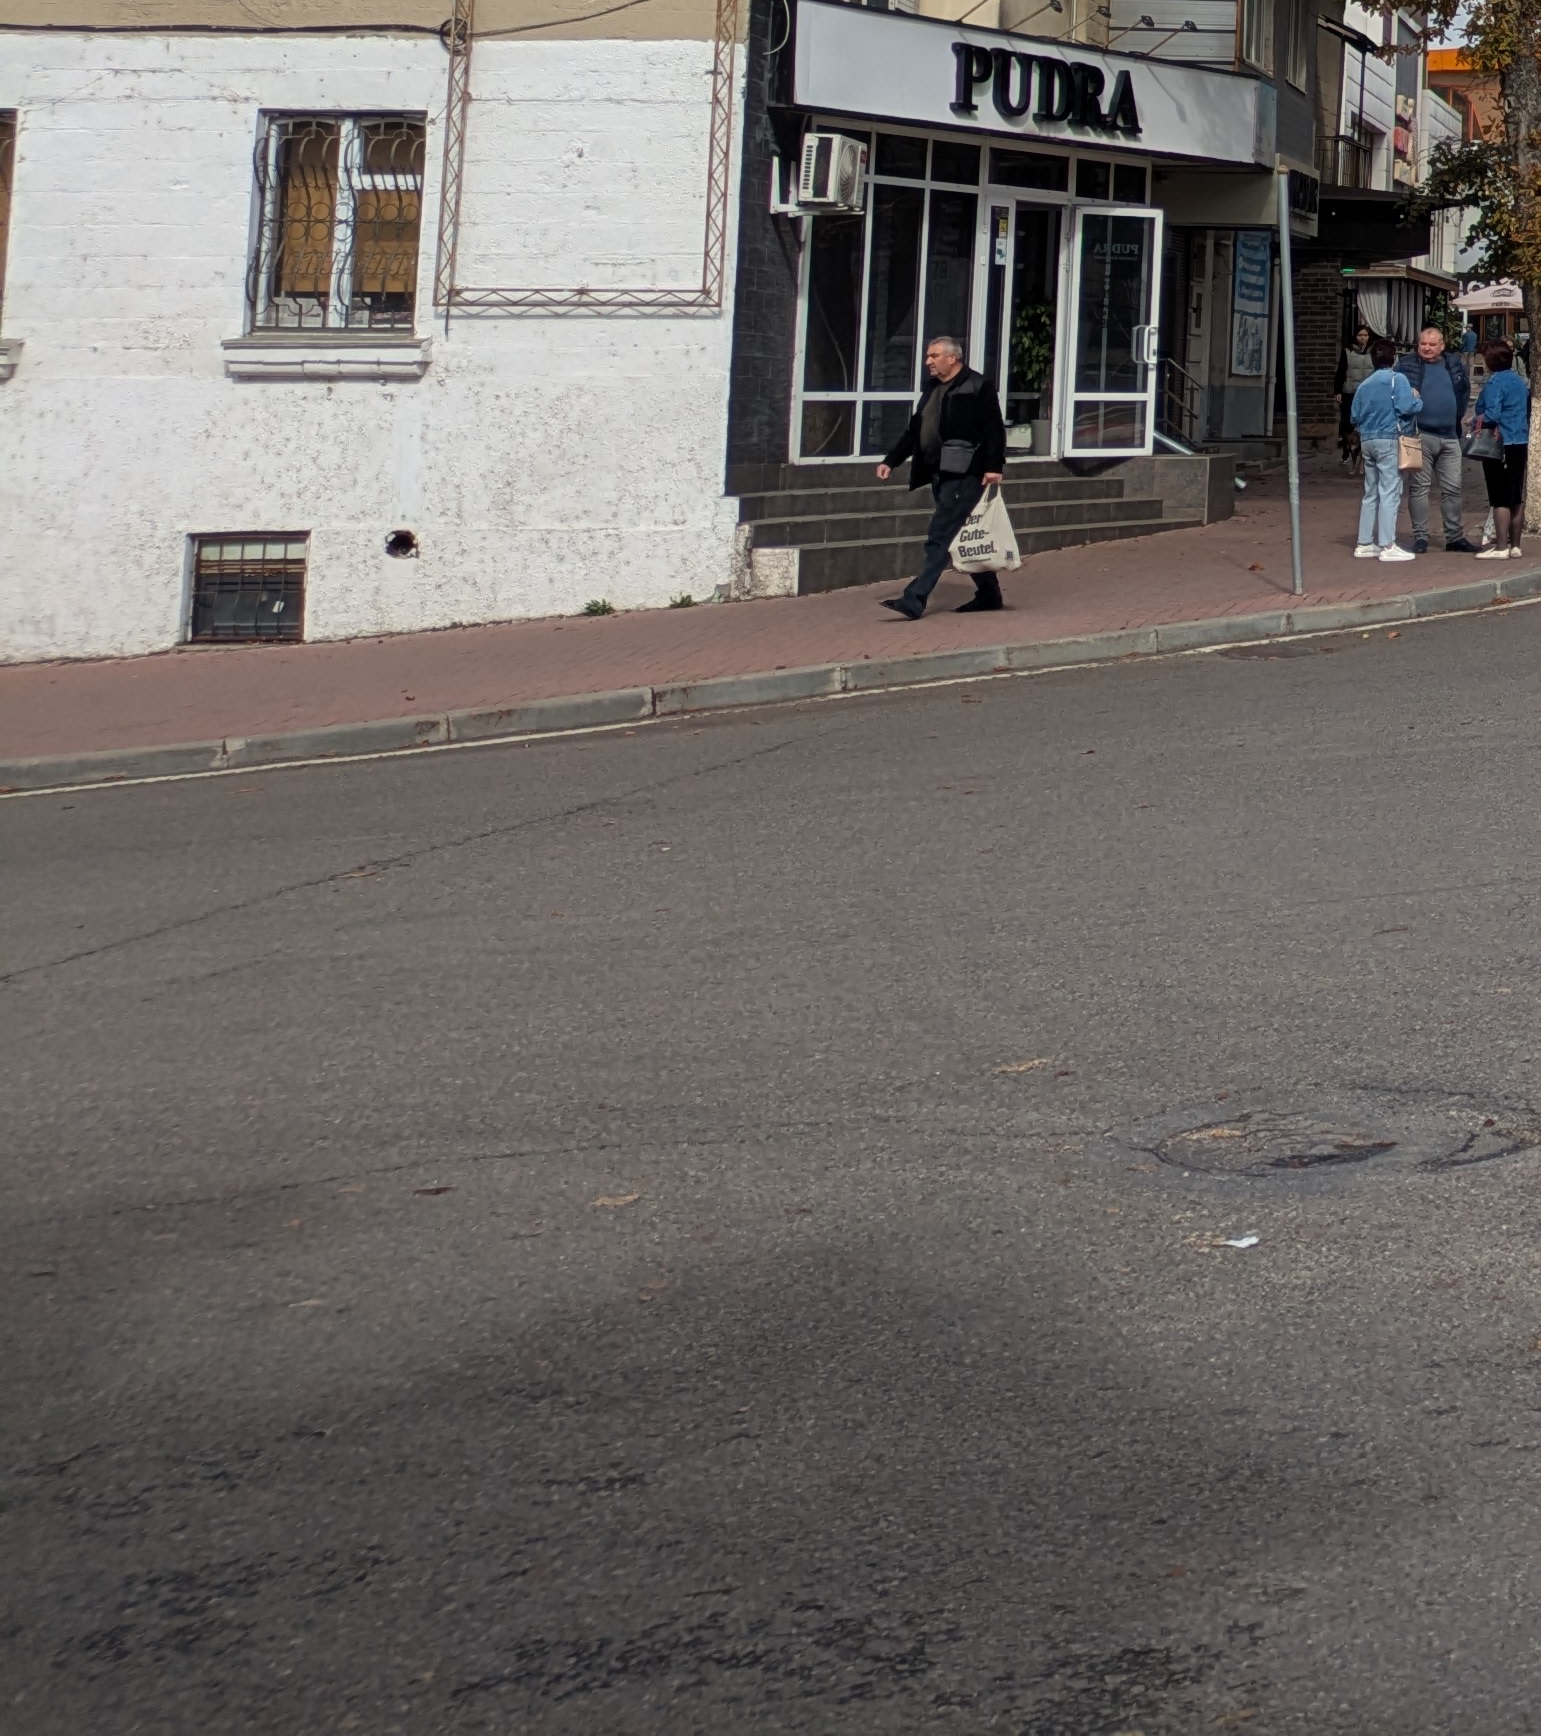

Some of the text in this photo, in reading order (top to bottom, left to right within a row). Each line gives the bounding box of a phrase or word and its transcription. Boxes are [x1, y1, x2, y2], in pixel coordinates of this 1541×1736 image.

[949, 42, 1143, 134] PUDRA
[960, 529, 989, 542] Gute-
[958, 540, 997, 557] Beutel.
